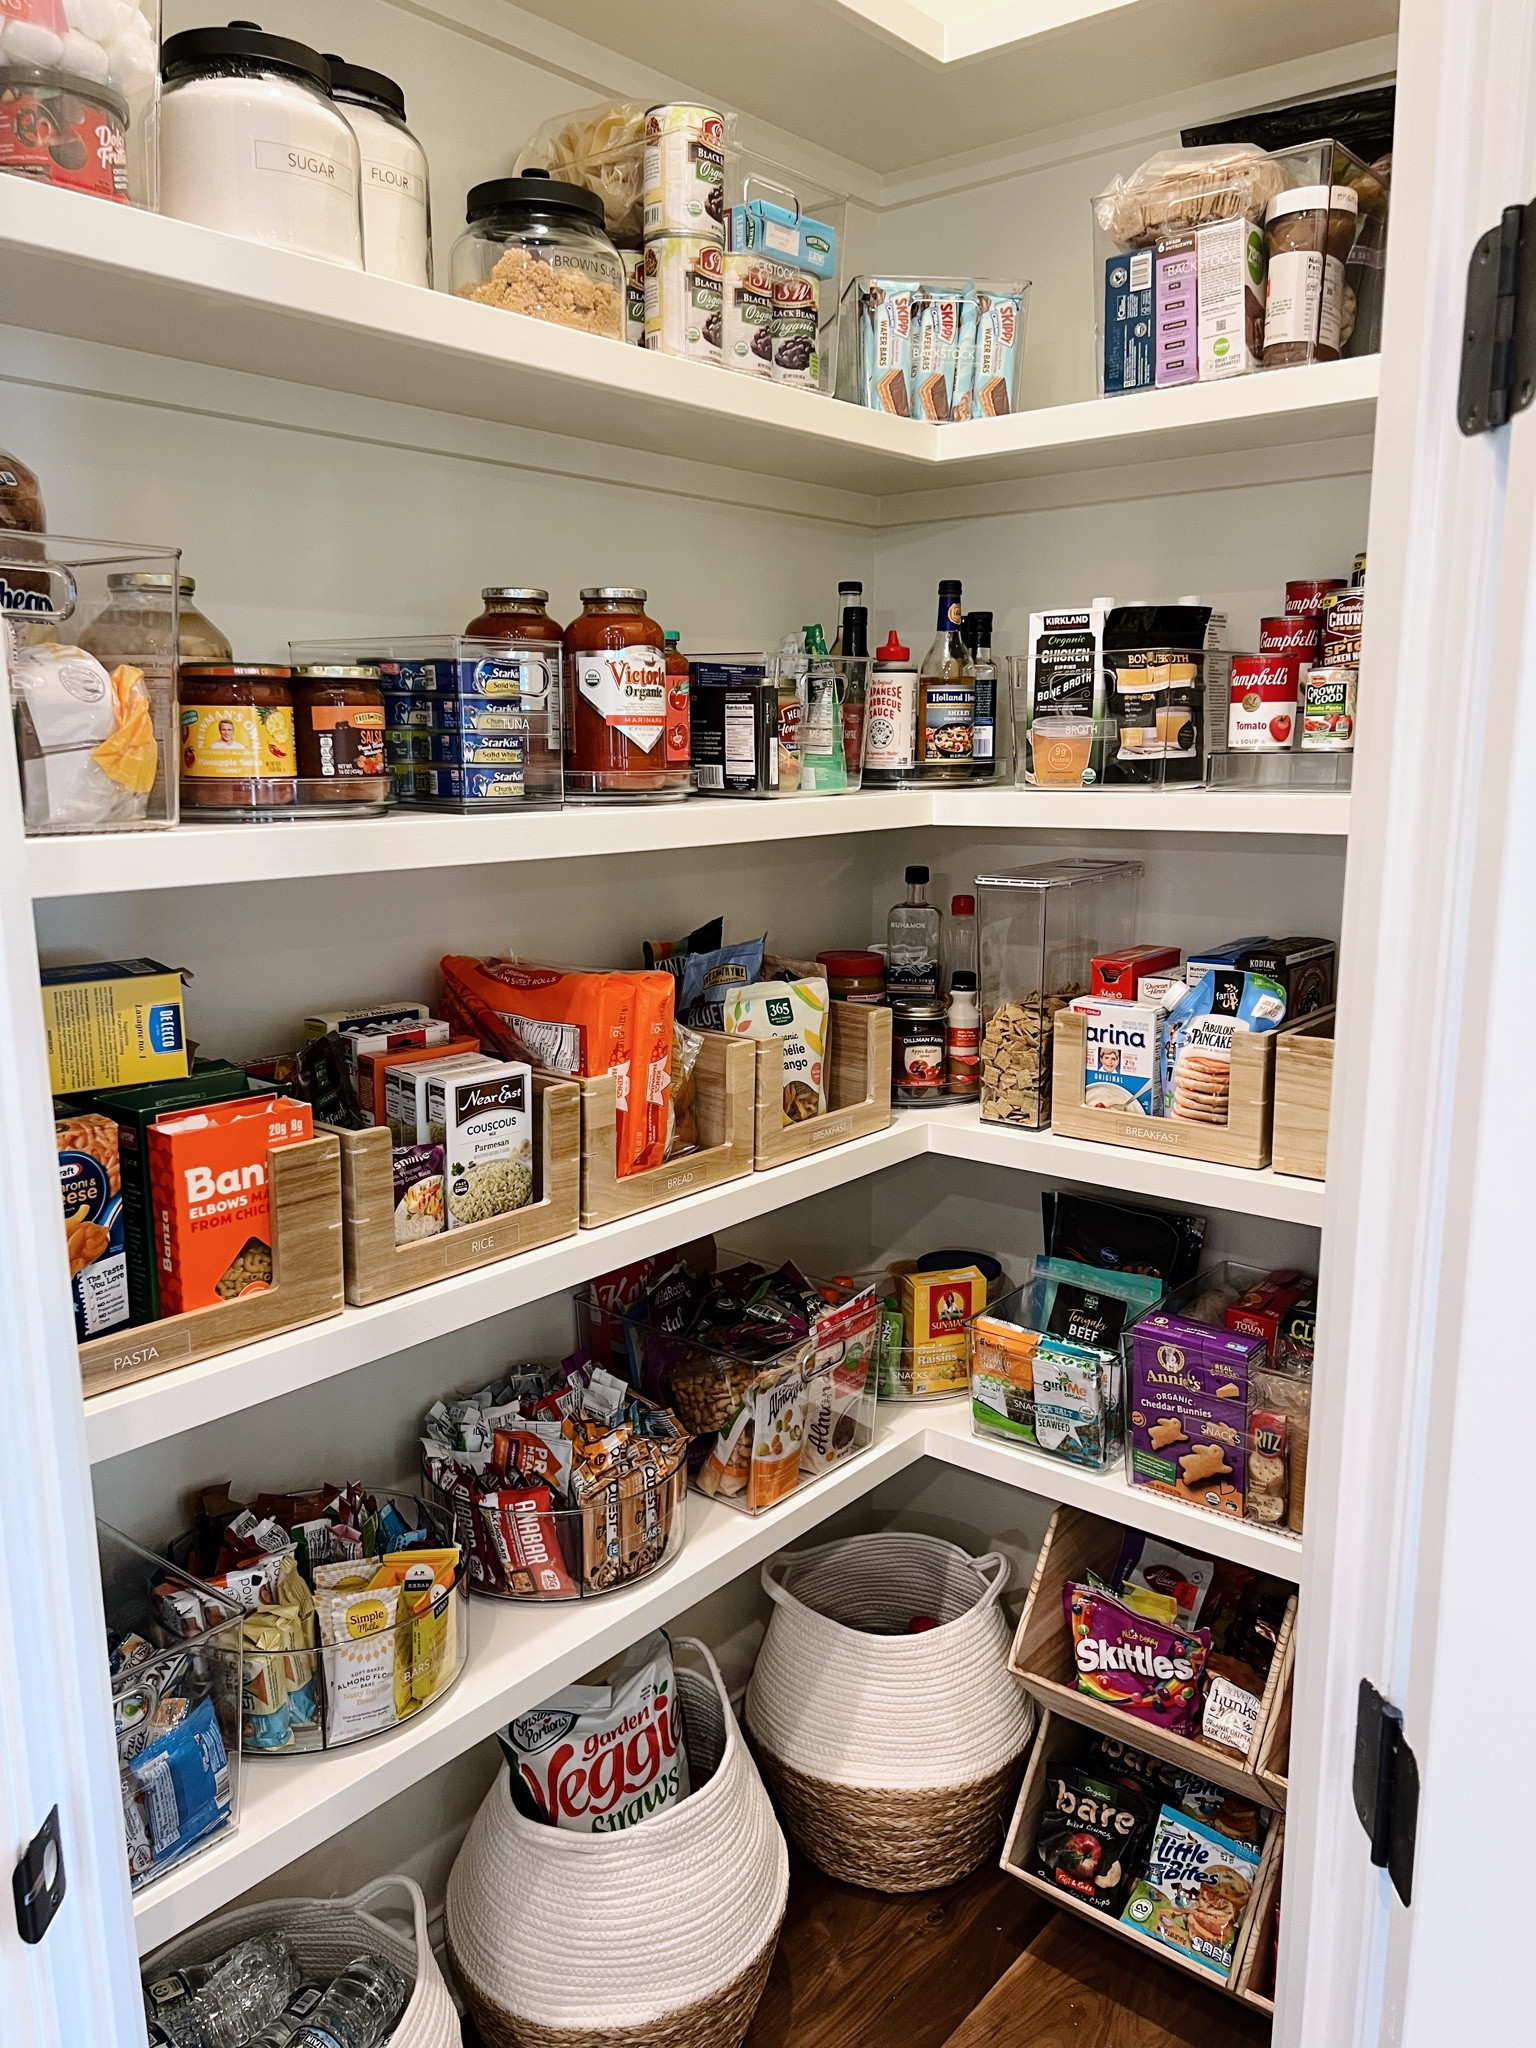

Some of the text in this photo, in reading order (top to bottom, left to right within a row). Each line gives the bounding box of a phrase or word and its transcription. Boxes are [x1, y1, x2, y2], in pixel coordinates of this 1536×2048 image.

[288, 152, 335, 180] SUGAR
[371, 167, 410, 190] FLOUR
[1158, 242, 1165, 253] 6
[554, 254, 598, 274] BROWN
[895, 297, 909, 337] SKIPPY
[940, 303, 954, 342] SKIPPY
[1000, 306, 1014, 345] SKIPPY
[879, 320, 888, 366] WAFER BARS
[982, 328, 993, 374] WAFER BARS
[1046, 615, 1089, 626] KIRKLAND
[1329, 612, 1363, 627] CHUN
[1048, 635, 1086, 648] Organic
[1260, 629, 1318, 651] Campbell's
[1041, 649, 1091, 664] CHICKEN
[1324, 654, 1350, 666] CHICKEN
[1037, 673, 1092, 702] BONE BROTH
[1231, 667, 1288, 690] Campbell's
[625, 685, 662, 700] Organic
[932, 693, 963, 702] Holland
[1307, 684, 1344, 702] GROWN
[1314, 693, 1344, 705] GOOD
[869, 709, 894, 720] SAUCE
[501, 718, 530, 730] TUNA
[1065, 724, 1098, 735] BROTH
[1236, 720, 1267, 731] Tomato
[361, 731, 383, 744] SALSA
[481, 737, 519, 748] StarKist
[1055, 747, 1067, 758] 9g
[1250, 959, 1277, 969] KODIAK
[511, 976, 557, 986] SWEET ROLLS
[769, 1002, 790, 1017] 365
[135, 1004, 144, 1039] Lasagne
[393, 1022, 439, 1033] BARLEY
[1202, 1022, 1236, 1034] FABULOUS
[1087, 1024, 1146, 1048] arina
[1192, 1029, 1232, 1049] PANCAKE
[783, 1059, 808, 1071] ango
[1094, 1073, 1124, 1084] ORIGINAL
[460, 1088, 498, 1111] Near
[498, 1084, 522, 1104] East
[269, 1119, 303, 1137] 20g 8g
[467, 1117, 517, 1136] COUSCOUS
[813, 1123, 848, 1141] BREAKFAST
[1126, 1126, 1180, 1144] BREAKFAST
[474, 1139, 510, 1152] Parmesan
[59, 1168, 75, 1177] raft
[667, 1173, 694, 1190] BREAD
[61, 1178, 97, 1194] aroni &
[189, 1195, 248, 1220] ELBOWS
[190, 1214, 232, 1233] FROM
[162, 1210, 173, 1273] Banza
[472, 1236, 495, 1254] RICE
[87, 1262, 124, 1284] The Taste
[90, 1272, 125, 1291] You Love
[97, 1302, 106, 1310] NO
[99, 1312, 107, 1320] NO
[661, 1306, 684, 1333] stal
[1068, 1308, 1108, 1331] Teriyaki
[1068, 1324, 1099, 1342] BEEF
[1234, 1320, 1265, 1336] TOWN
[113, 1347, 159, 1370] PASTA
[917, 1353, 958, 1365] Raisins
[892, 1371, 928, 1381] SNACKS
[1147, 1369, 1201, 1393] Annie's
[1140, 1398, 1212, 1419] Cheddar Bunnies
[1156, 1393, 1193, 1406] ORGANIC
[1038, 1418, 1071, 1433] SEAWEED
[1200, 1425, 1240, 1444] SNACKS
[1254, 1429, 1281, 1452] RITZ
[645, 1464, 656, 1511] QUEST
[606, 1479, 618, 1526] QUEST
[515, 1499, 549, 1565] ANABAR
[641, 1526, 661, 1543] BARS
[547, 1574, 557, 1589] 21G
[350, 1611, 384, 1625] Simple
[357, 1623, 380, 1634] Mills
[1076, 1638, 1195, 1681] Skittles
[404, 1659, 430, 1682] BARS
[337, 1675, 371, 1691] ALMOND
[1213, 1689, 1257, 1721] hunks
[525, 1714, 569, 1748] Portions
[582, 1706, 650, 1762] garden
[1204, 1727, 1219, 1739] DARK
[521, 1694, 683, 1828] Veggie
[591, 1765, 681, 1833] Straws
[1084, 1786, 1111, 1801] Organic
[1056, 1780, 1136, 1835] bare
[1066, 1819, 1113, 1840] Baked Crunchy
[1157, 1835, 1209, 1865] Little
[1163, 1860, 1219, 1886] Bites
[1058, 1874, 1093, 1893] Fuji Reds
[1089, 1897, 1110, 1906] Chips
